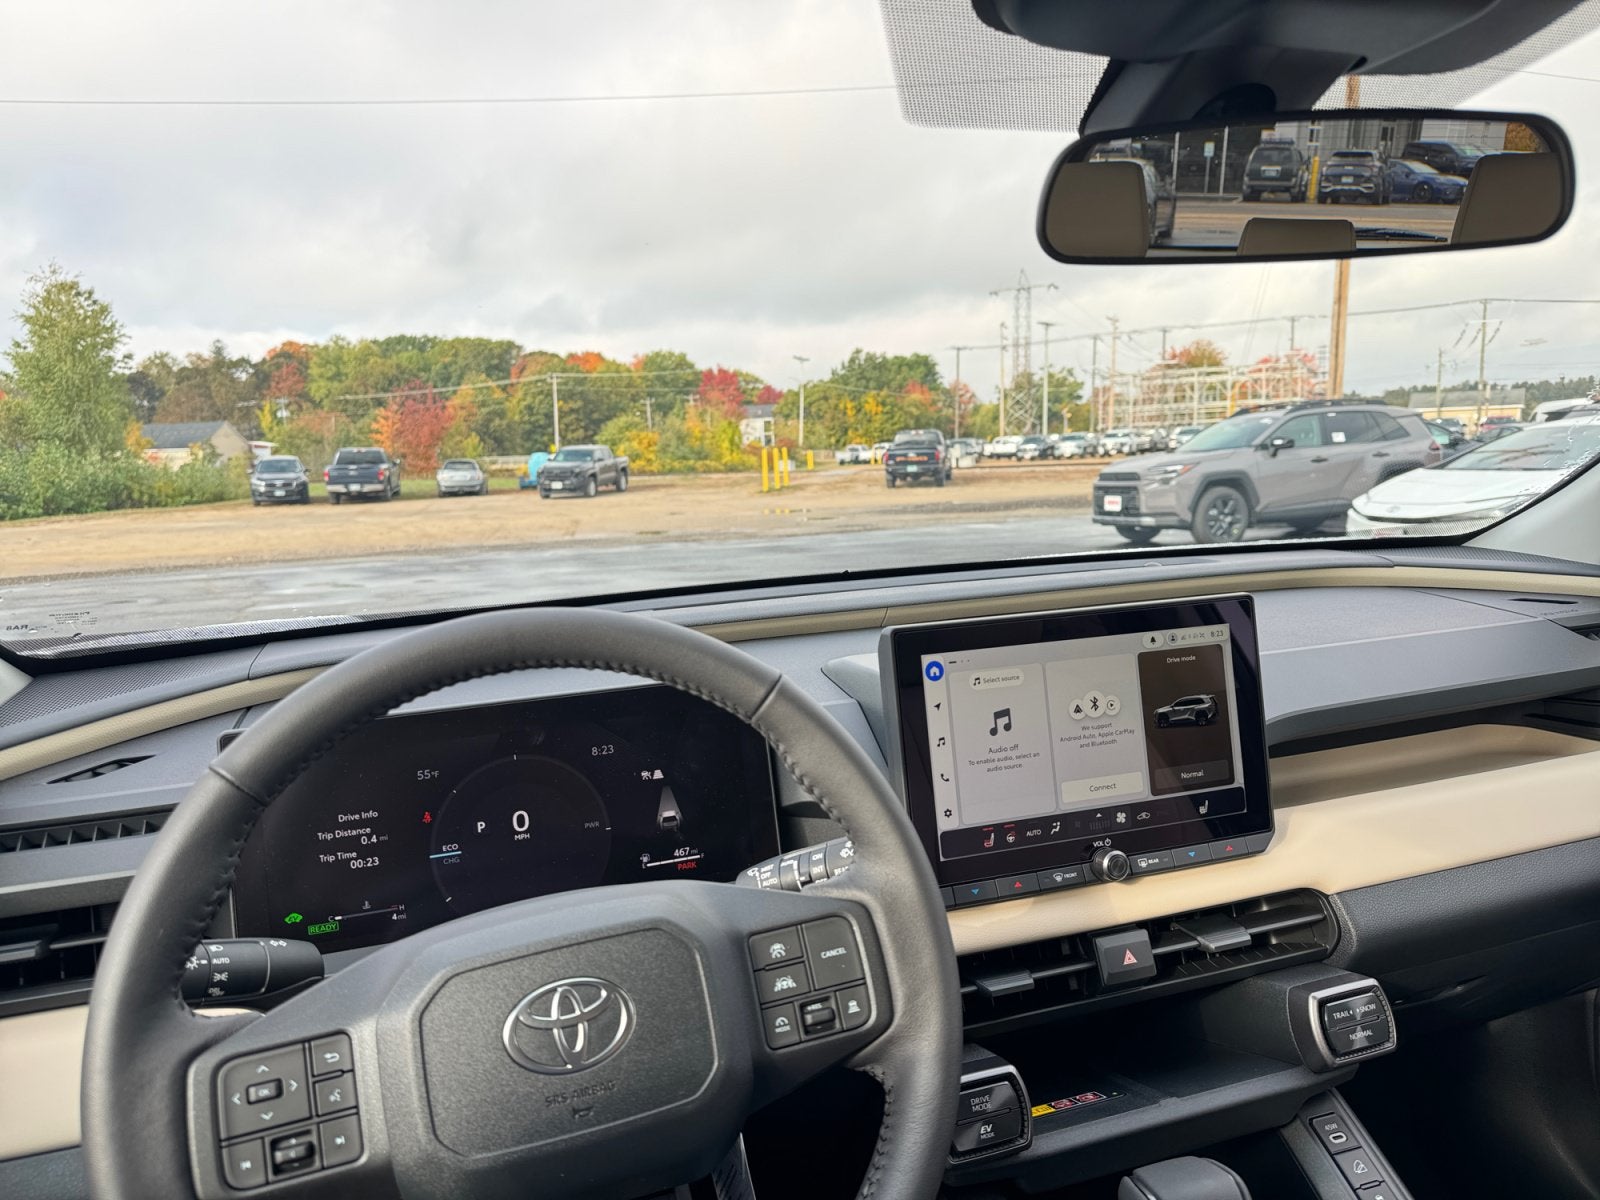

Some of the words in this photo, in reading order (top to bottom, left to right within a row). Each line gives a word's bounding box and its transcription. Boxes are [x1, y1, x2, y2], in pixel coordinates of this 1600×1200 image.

[1210, 630, 1224, 638] 8:23
[982, 676, 1000, 684] Select
[1001, 674, 1020, 682] source
[1091, 722, 1113, 731] support
[1060, 734, 1082, 743] Android
[1098, 731, 1114, 739] Apple
[1114, 728, 1135, 737] CarPlay
[1091, 738, 1118, 747] Bluetooth
[590, 744, 615, 756] 8:23
[988, 746, 1008, 754] Audio
[1009, 744, 1019, 752] off
[976, 757, 996, 765] enable
[997, 755, 1014, 763] audio,
[1180, 770, 1204, 779] Normal
[1089, 783, 1117, 792] Connect
[338, 814, 360, 823] Drive
[361, 810, 379, 819] Info
[511, 810, 530, 832] 0
[476, 821, 486, 833] P
[584, 820, 600, 829] PWR
[317, 832, 334, 841] Trip
[335, 827, 371, 838] Distance
[514, 833, 531, 841] MPH
[1026, 829, 1042, 837] AUTO
[361, 834, 378, 845] 0.4
[1093, 840, 1104, 848] VOL
[442, 843, 459, 852] ECO
[673, 847, 690, 857] 467
[319, 854, 336, 863] Trip
[337, 851, 357, 860] Time
[443, 856, 461, 865] CHG
[350, 856, 380, 869] 00:23
[677, 861, 697, 870] PARK
[1064, 871, 1078, 879] FRONT
[762, 878, 778, 887] AUTO
[309, 922, 338, 933] READY
[820, 947, 847, 959] CANCEL
[212, 957, 230, 965] AUTO
[1359, 1003, 1377, 1013] SNOW
[1332, 1010, 1350, 1020] TRAIL
[1349, 1029, 1373, 1040] NORMAL
[258, 1087, 271, 1097] OK
[545, 1092, 568, 1108] SRS
[572, 1080, 617, 1099] AIRBAG
[970, 1094, 990, 1106] DRIVE
[971, 1101, 992, 1113] MODE
[980, 1124, 993, 1134] EV
[980, 1131, 995, 1140] MODE
